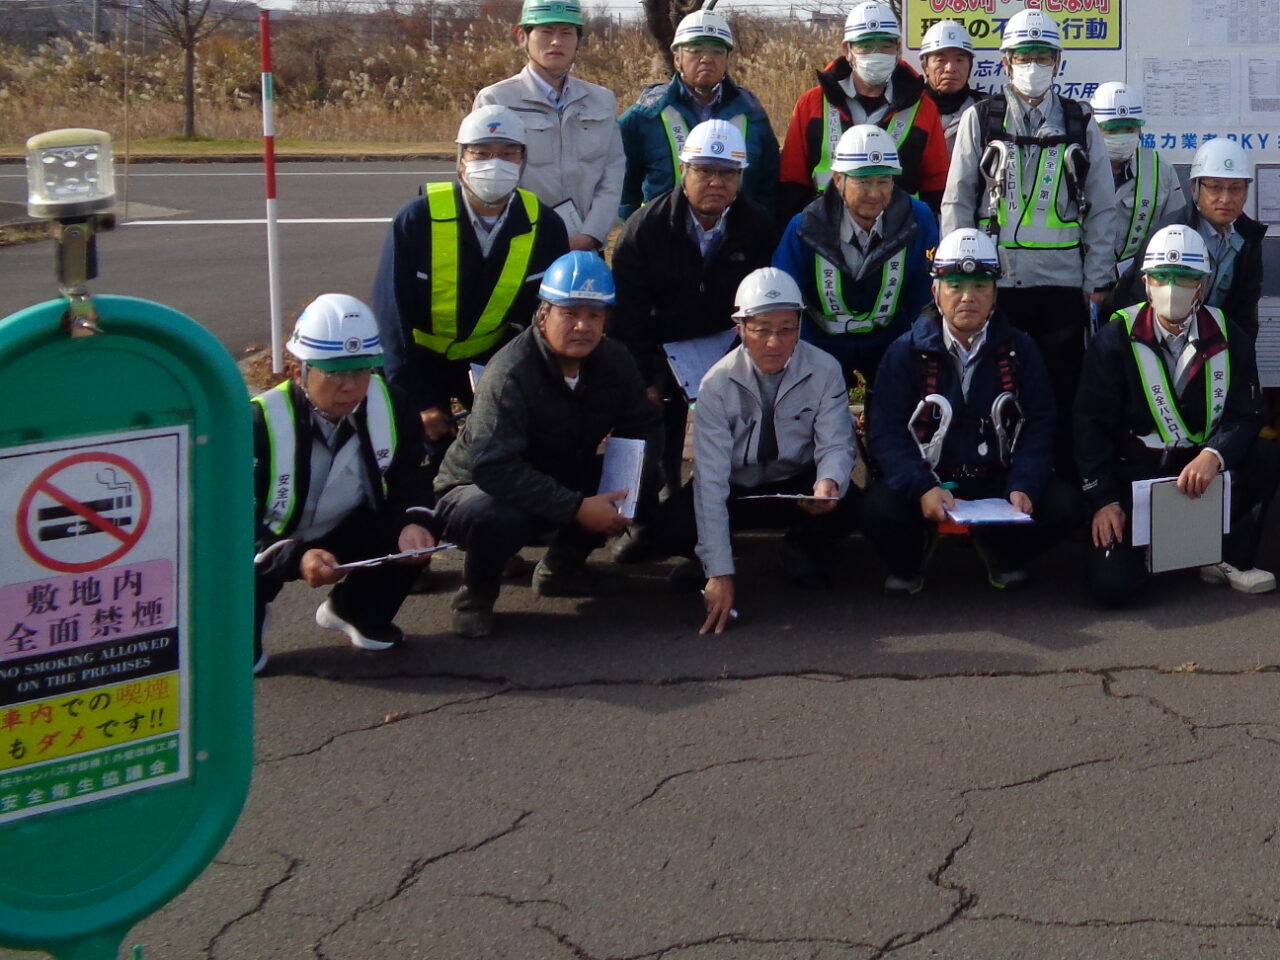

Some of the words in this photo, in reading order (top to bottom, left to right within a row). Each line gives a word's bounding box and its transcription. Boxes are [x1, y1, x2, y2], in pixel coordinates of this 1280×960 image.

[1213, 370, 1224, 398] 安全
[26, 569, 143, 616] 敷地内
[4, 597, 164, 654] 全面禁煙
[0, 667, 19, 679] NO
[25, 652, 94, 674] SMOKING
[101, 637, 171, 659] ALLOWED
[17, 681, 39, 691] ON
[47, 673, 76, 685] THE
[81, 657, 152, 680] PREMISES
[0, 678, 170, 732] 車内での喫煙
